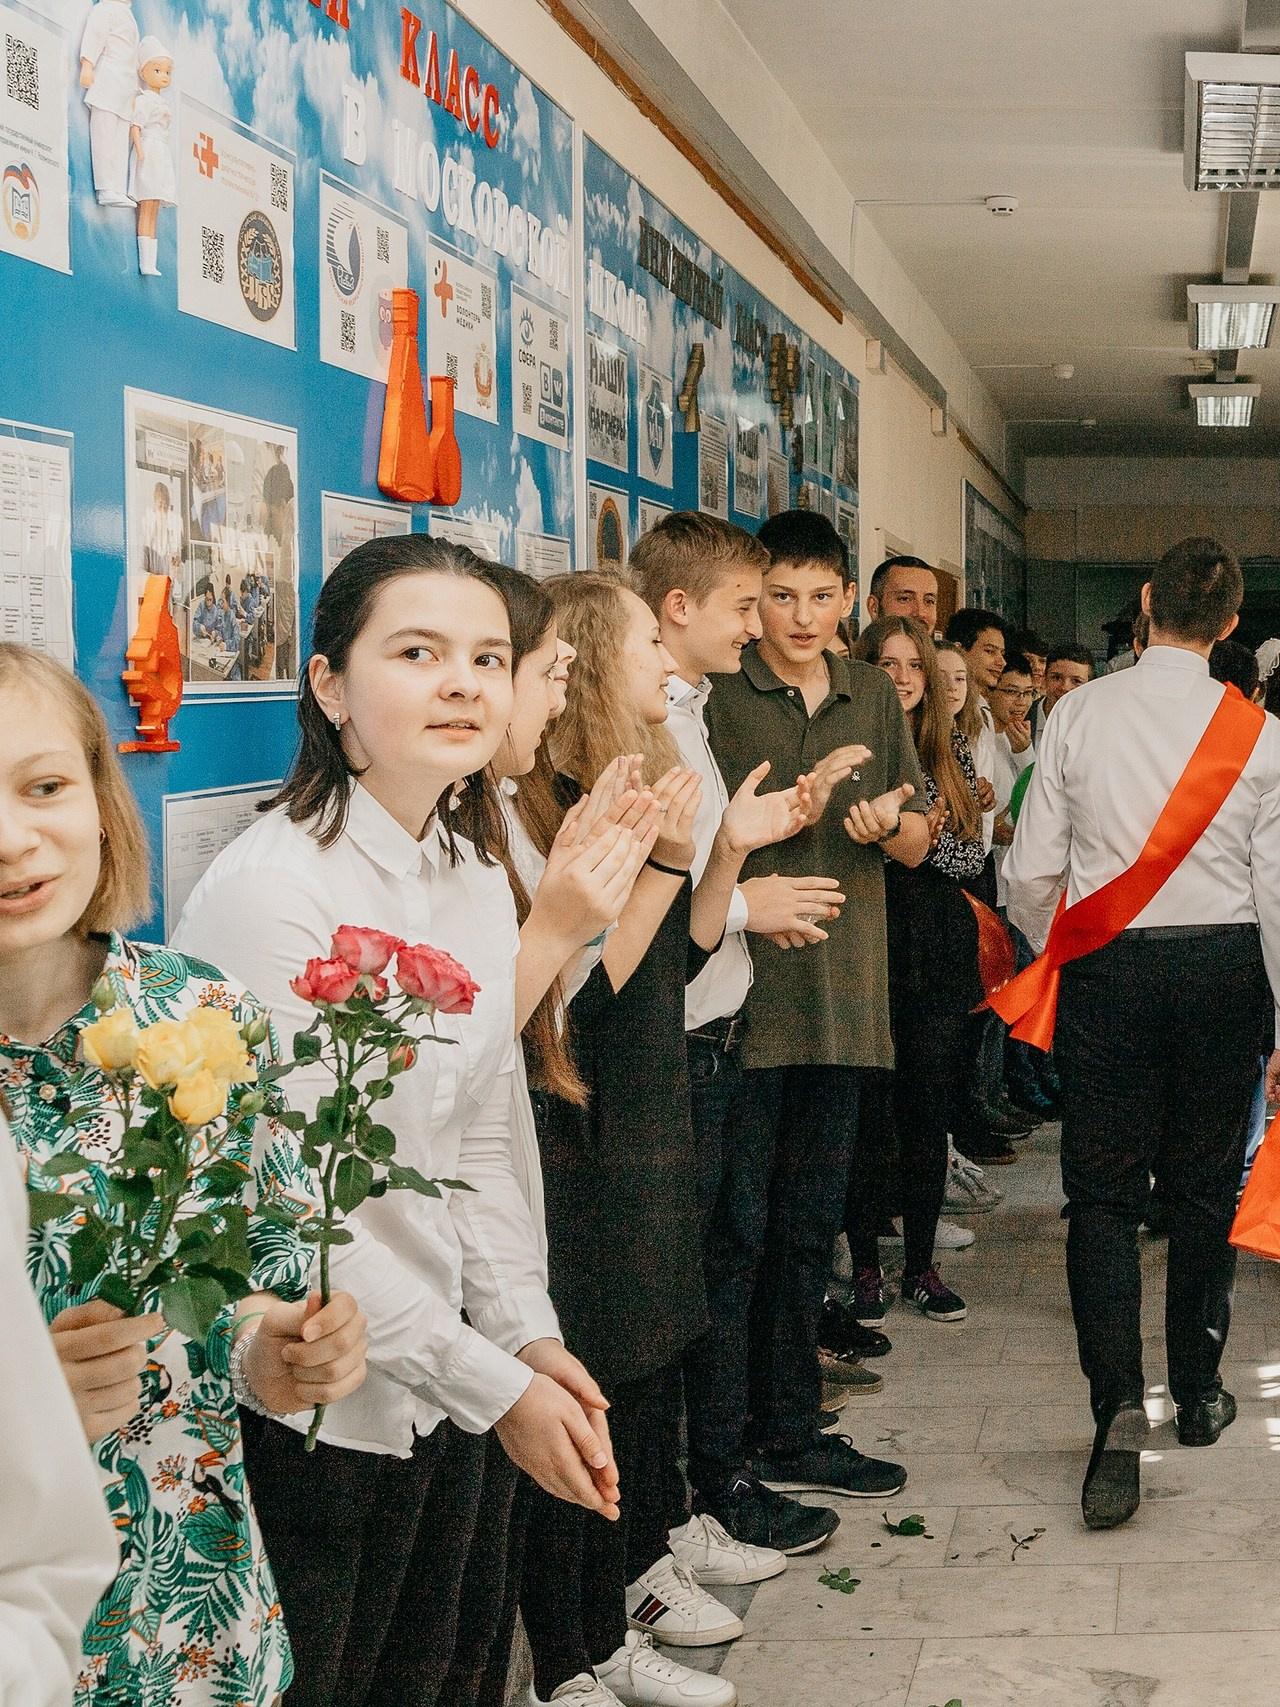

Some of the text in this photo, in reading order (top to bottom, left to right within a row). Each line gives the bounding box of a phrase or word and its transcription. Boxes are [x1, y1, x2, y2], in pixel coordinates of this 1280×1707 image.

[400, 6, 500, 149] КЛАСС
[343, 84, 367, 166] В
[392, 119, 572, 298] МОСКОВСКОЙ
[589, 259, 647, 347] ШКОЛЕ
[518, 348, 537, 369] СФЕРА
[589, 342, 625, 400] НАШИ
